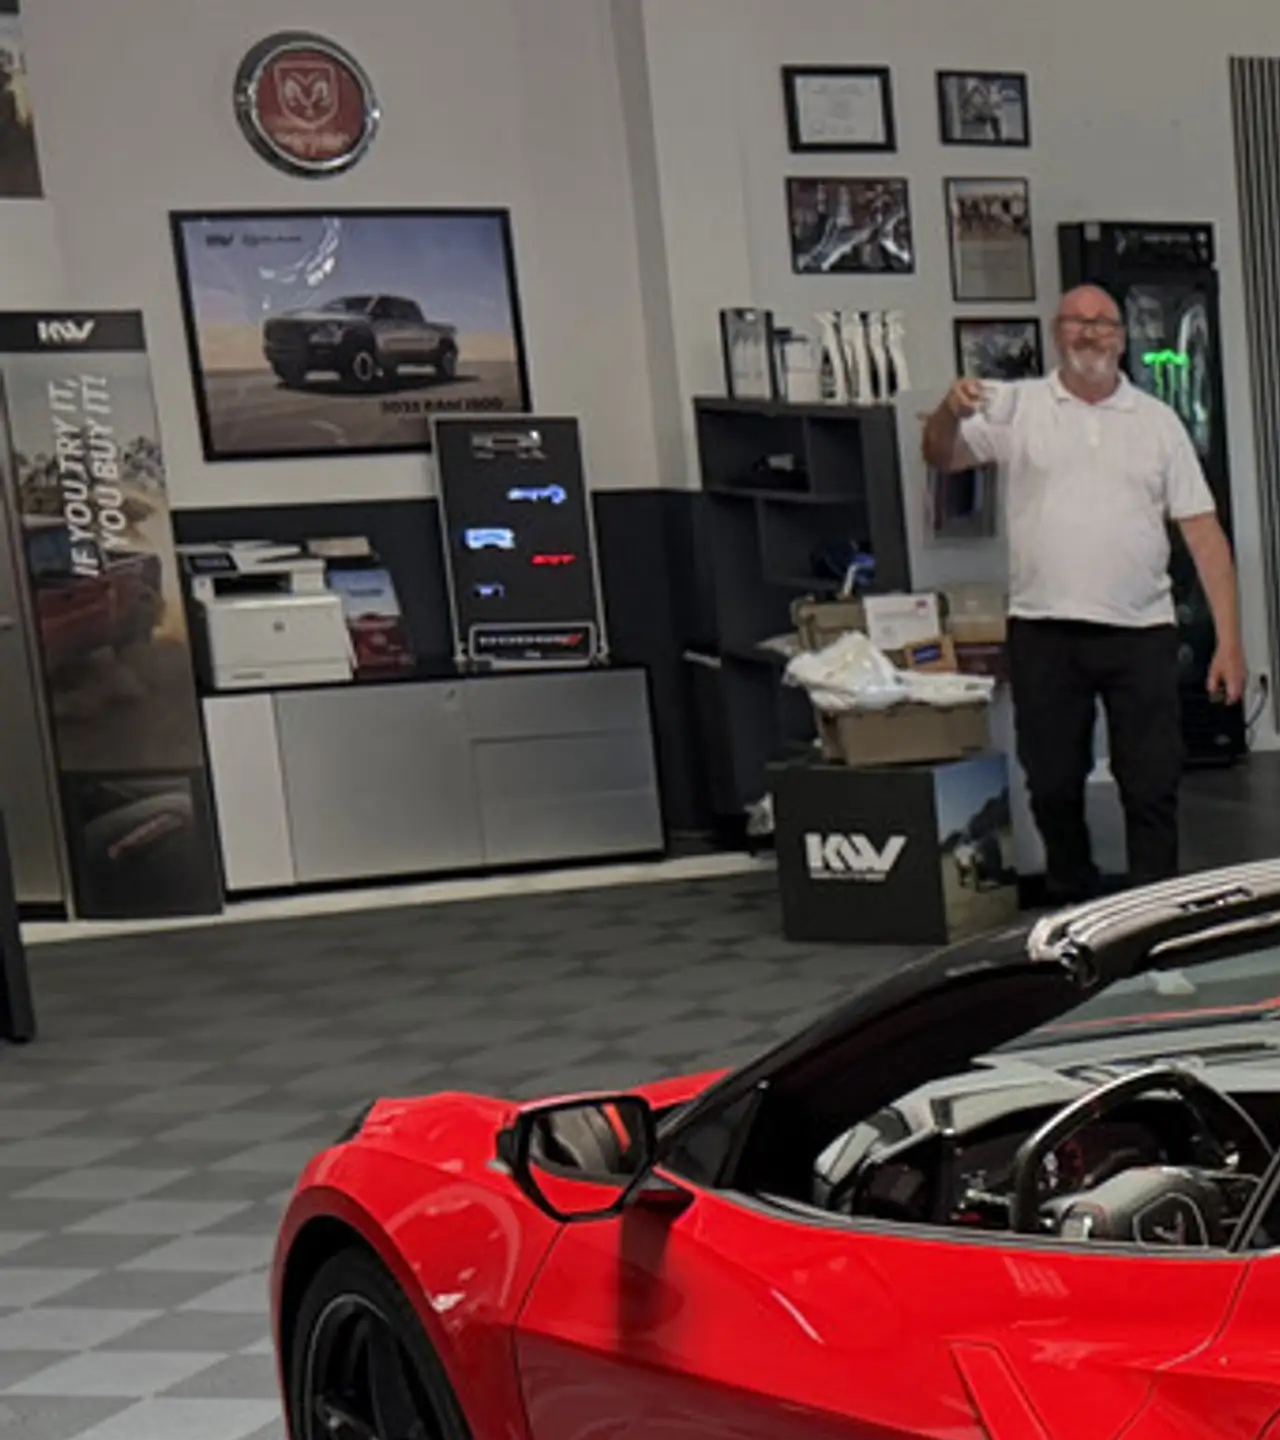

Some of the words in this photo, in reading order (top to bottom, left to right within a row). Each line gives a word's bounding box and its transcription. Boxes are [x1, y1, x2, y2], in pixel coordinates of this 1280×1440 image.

[53, 414, 88, 478] TRY
[87, 416, 119, 481] BUY
[62, 479, 96, 545] YOU
[97, 484, 130, 550] YOU
[71, 547, 100, 578] IF
